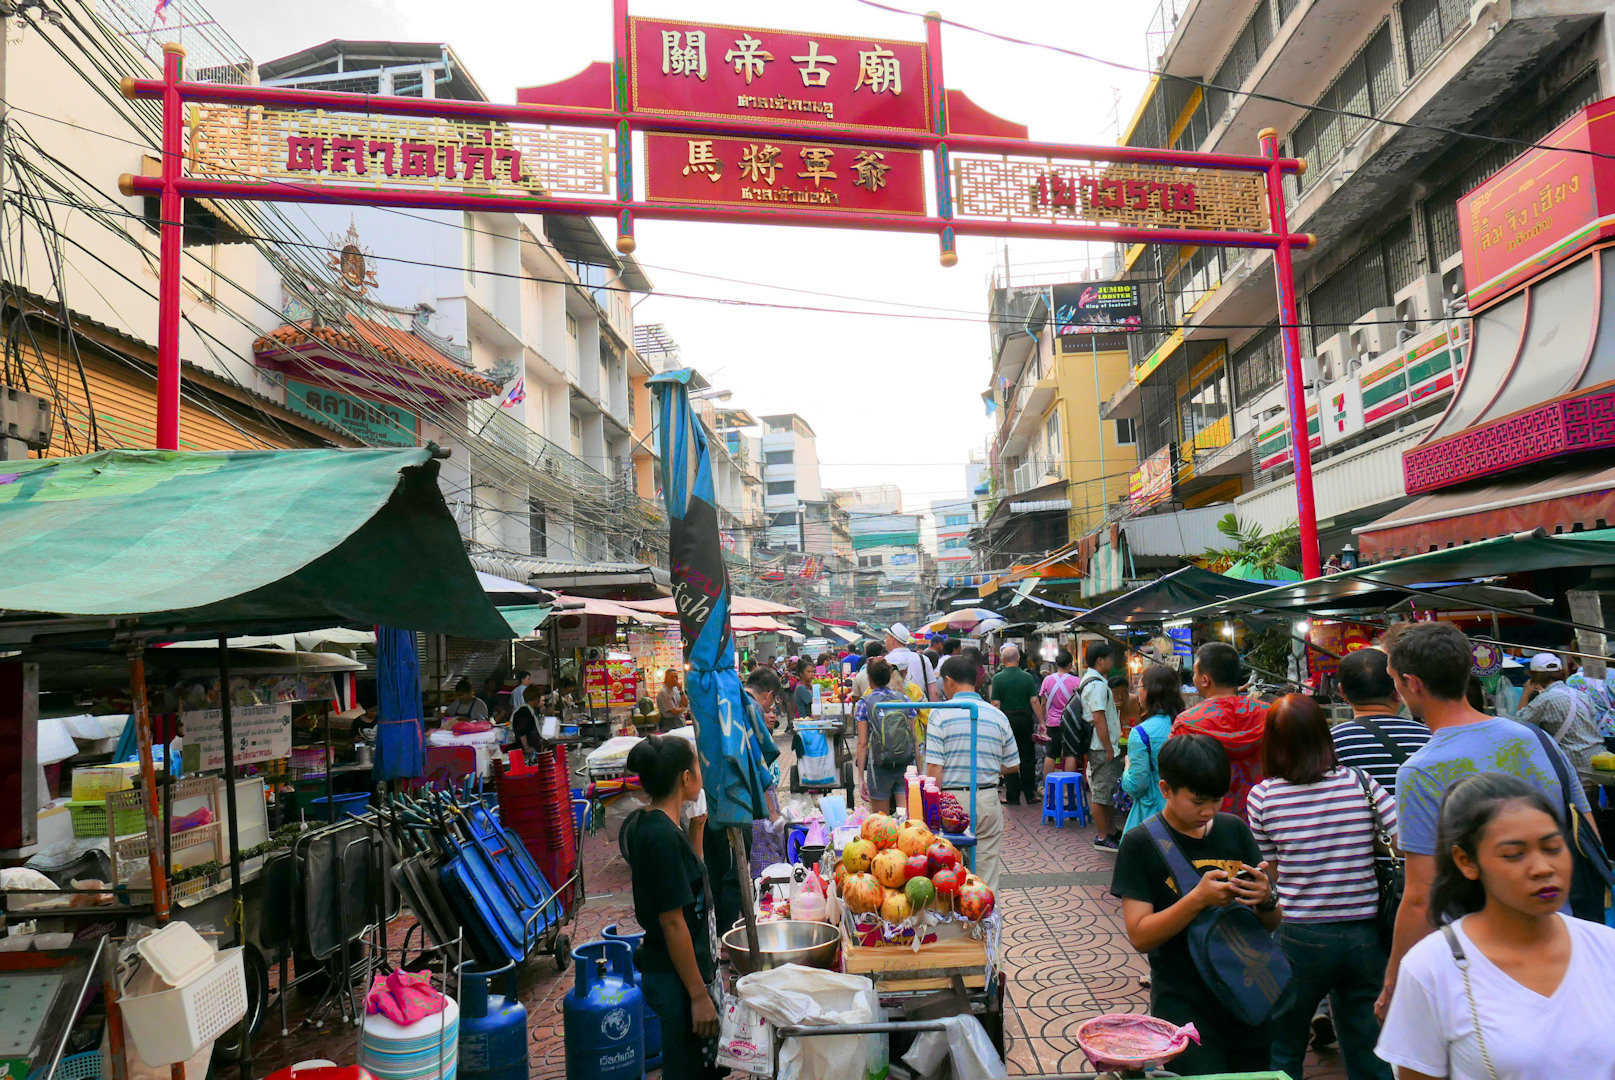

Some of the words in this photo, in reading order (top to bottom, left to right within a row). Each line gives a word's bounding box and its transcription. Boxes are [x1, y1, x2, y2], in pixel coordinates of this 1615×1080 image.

[661, 30, 902, 95] 關帝古廟
[286, 130, 524, 182] ตลาดเก่า
[682, 140, 891, 192] 馬將軍爺
[1037, 176, 1197, 212] เยาวราช
[1098, 285, 1131, 293] JUMBO
[306, 391, 400, 429] ตลาดเก่า
